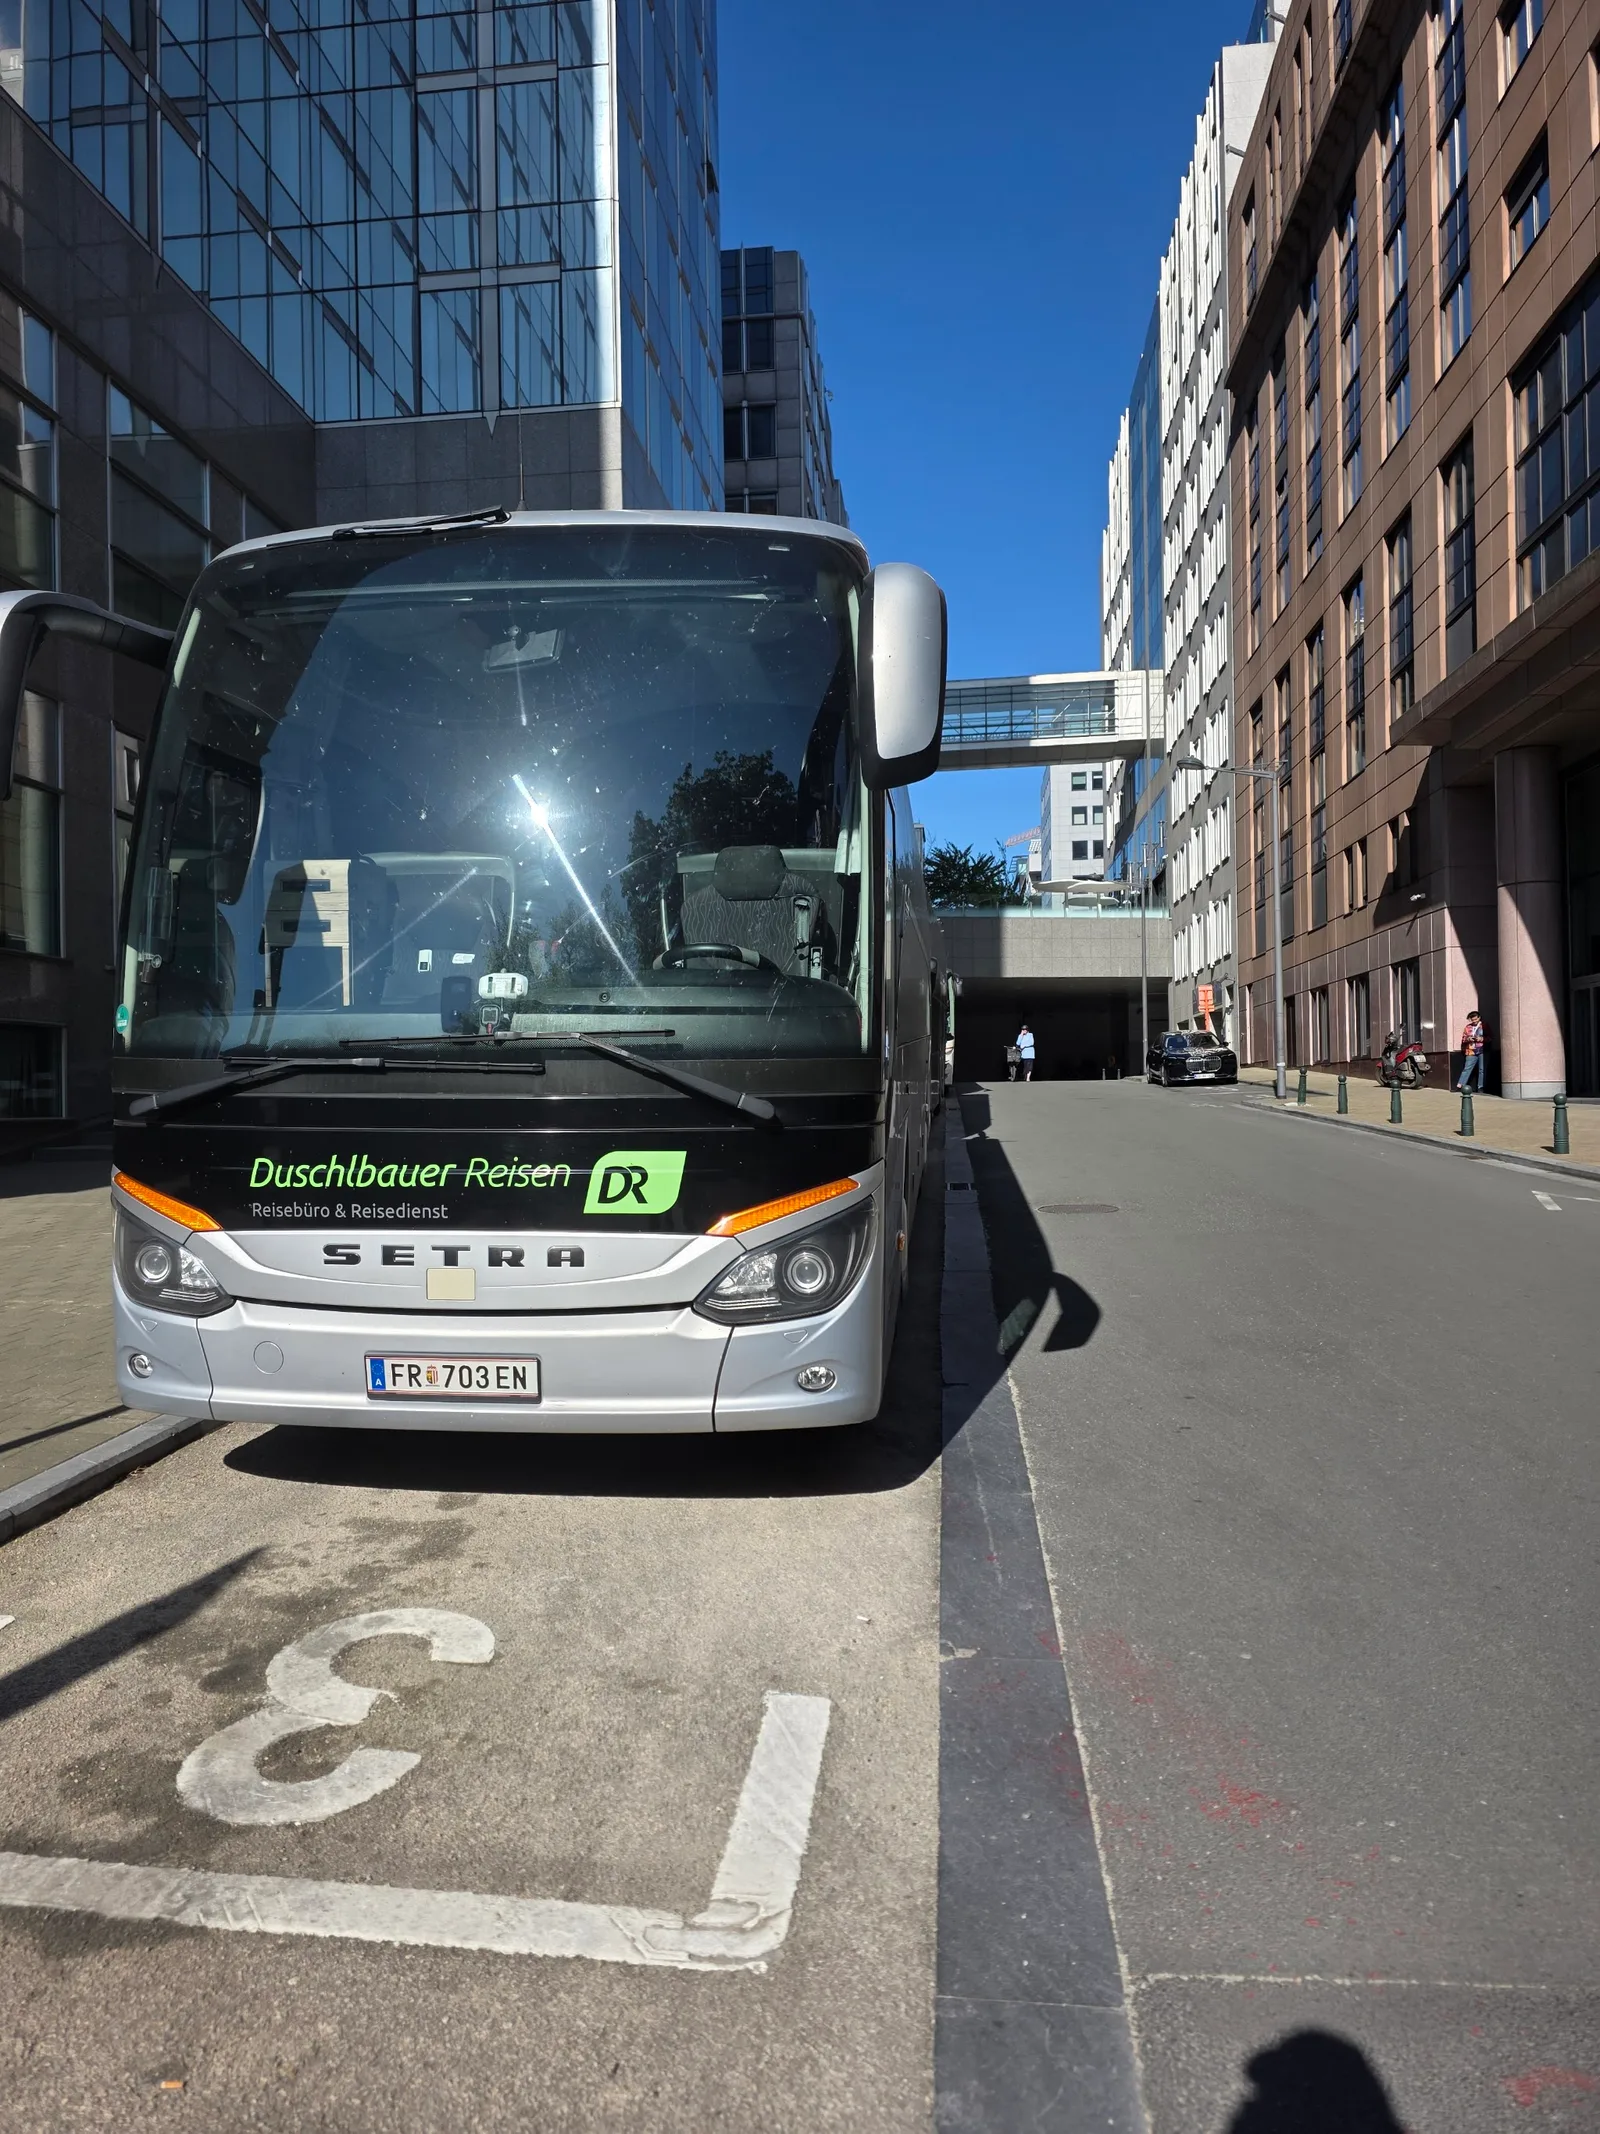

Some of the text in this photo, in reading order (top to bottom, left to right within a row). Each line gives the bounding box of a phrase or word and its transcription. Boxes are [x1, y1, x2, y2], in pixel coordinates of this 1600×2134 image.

[249, 1154, 571, 1188] Duschlbauer Reisen
[597, 1165, 649, 1205] DR
[252, 1202, 449, 1219] Reisebüro & Reisedienst
[322, 1243, 585, 1268] SETRA
[375, 1378, 383, 1386] A
